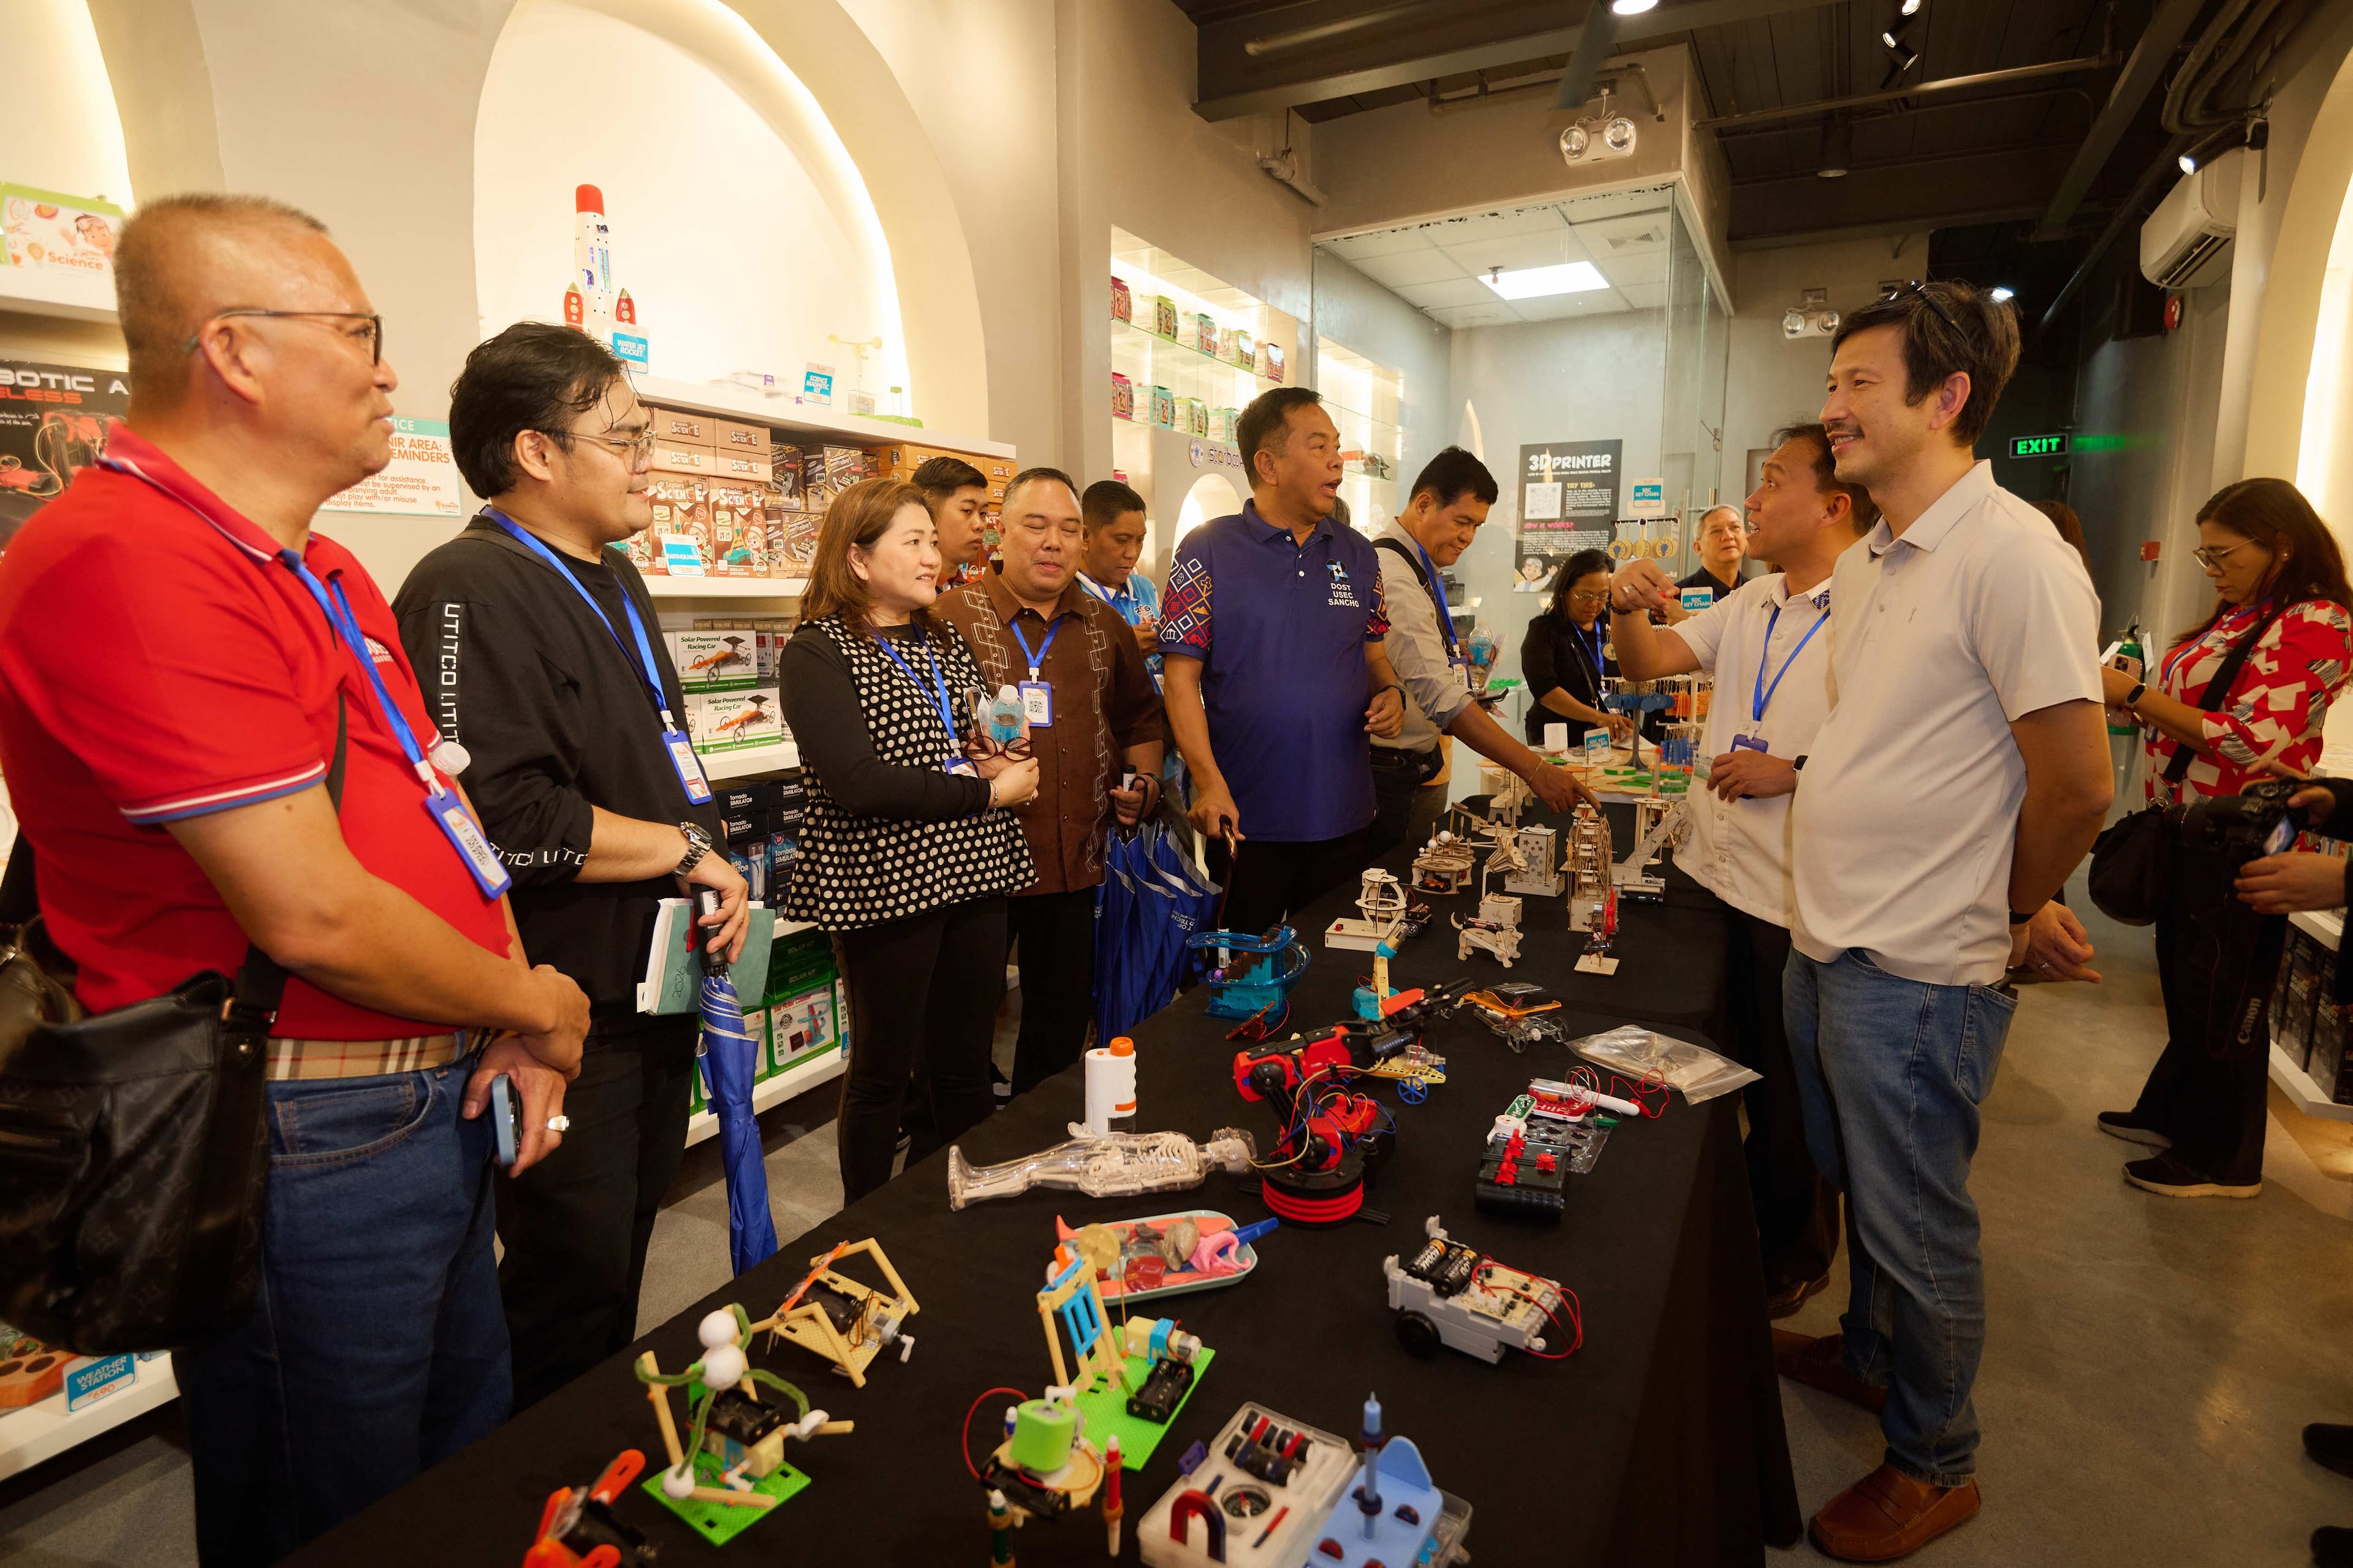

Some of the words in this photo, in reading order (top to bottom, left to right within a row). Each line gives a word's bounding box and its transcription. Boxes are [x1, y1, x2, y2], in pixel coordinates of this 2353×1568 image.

[48, 251, 104, 270] Science
[618, 339, 636, 349] WATER
[620, 347, 643, 357] ROCKET
[0, 369, 95, 392] BOTIC
[108, 380, 129, 395] A
[806, 380, 830, 390] MAGNETIC
[809, 375, 828, 384] SCIENCE
[0, 385, 83, 404] LESS
[382, 417, 415, 431] ICE
[409, 438, 442, 451] AREA:
[2017, 437, 2060, 454] EXIT
[390, 449, 450, 463] EMINDERS
[1552, 453, 1612, 469] PRINTER
[383, 482, 420, 491] supervised
[1331, 583, 1351, 591] DOST
[1333, 591, 1353, 599] USEC
[1328, 598, 1359, 608] SANCHO
[441, 604, 461, 686] UTITCO
[783, 787, 803, 796] SIMULATOR
[730, 797, 752, 806] SIMULATOR
[783, 812, 803, 821] SIMULATOR
[730, 823, 752, 833] SIMULATOR
[775, 847, 796, 857] Tornado
[775, 852, 796, 864] SIMULAT
[1171, 914, 1188, 925] TECH
[787, 944, 805, 954] SOLAR
[789, 972, 807, 983] SOLAR
[808, 969, 816, 978] KIT
[2237, 998, 2262, 1044] Canon
[77, 1355, 127, 1384] WEATHER
[81, 1364, 124, 1390] STATION
